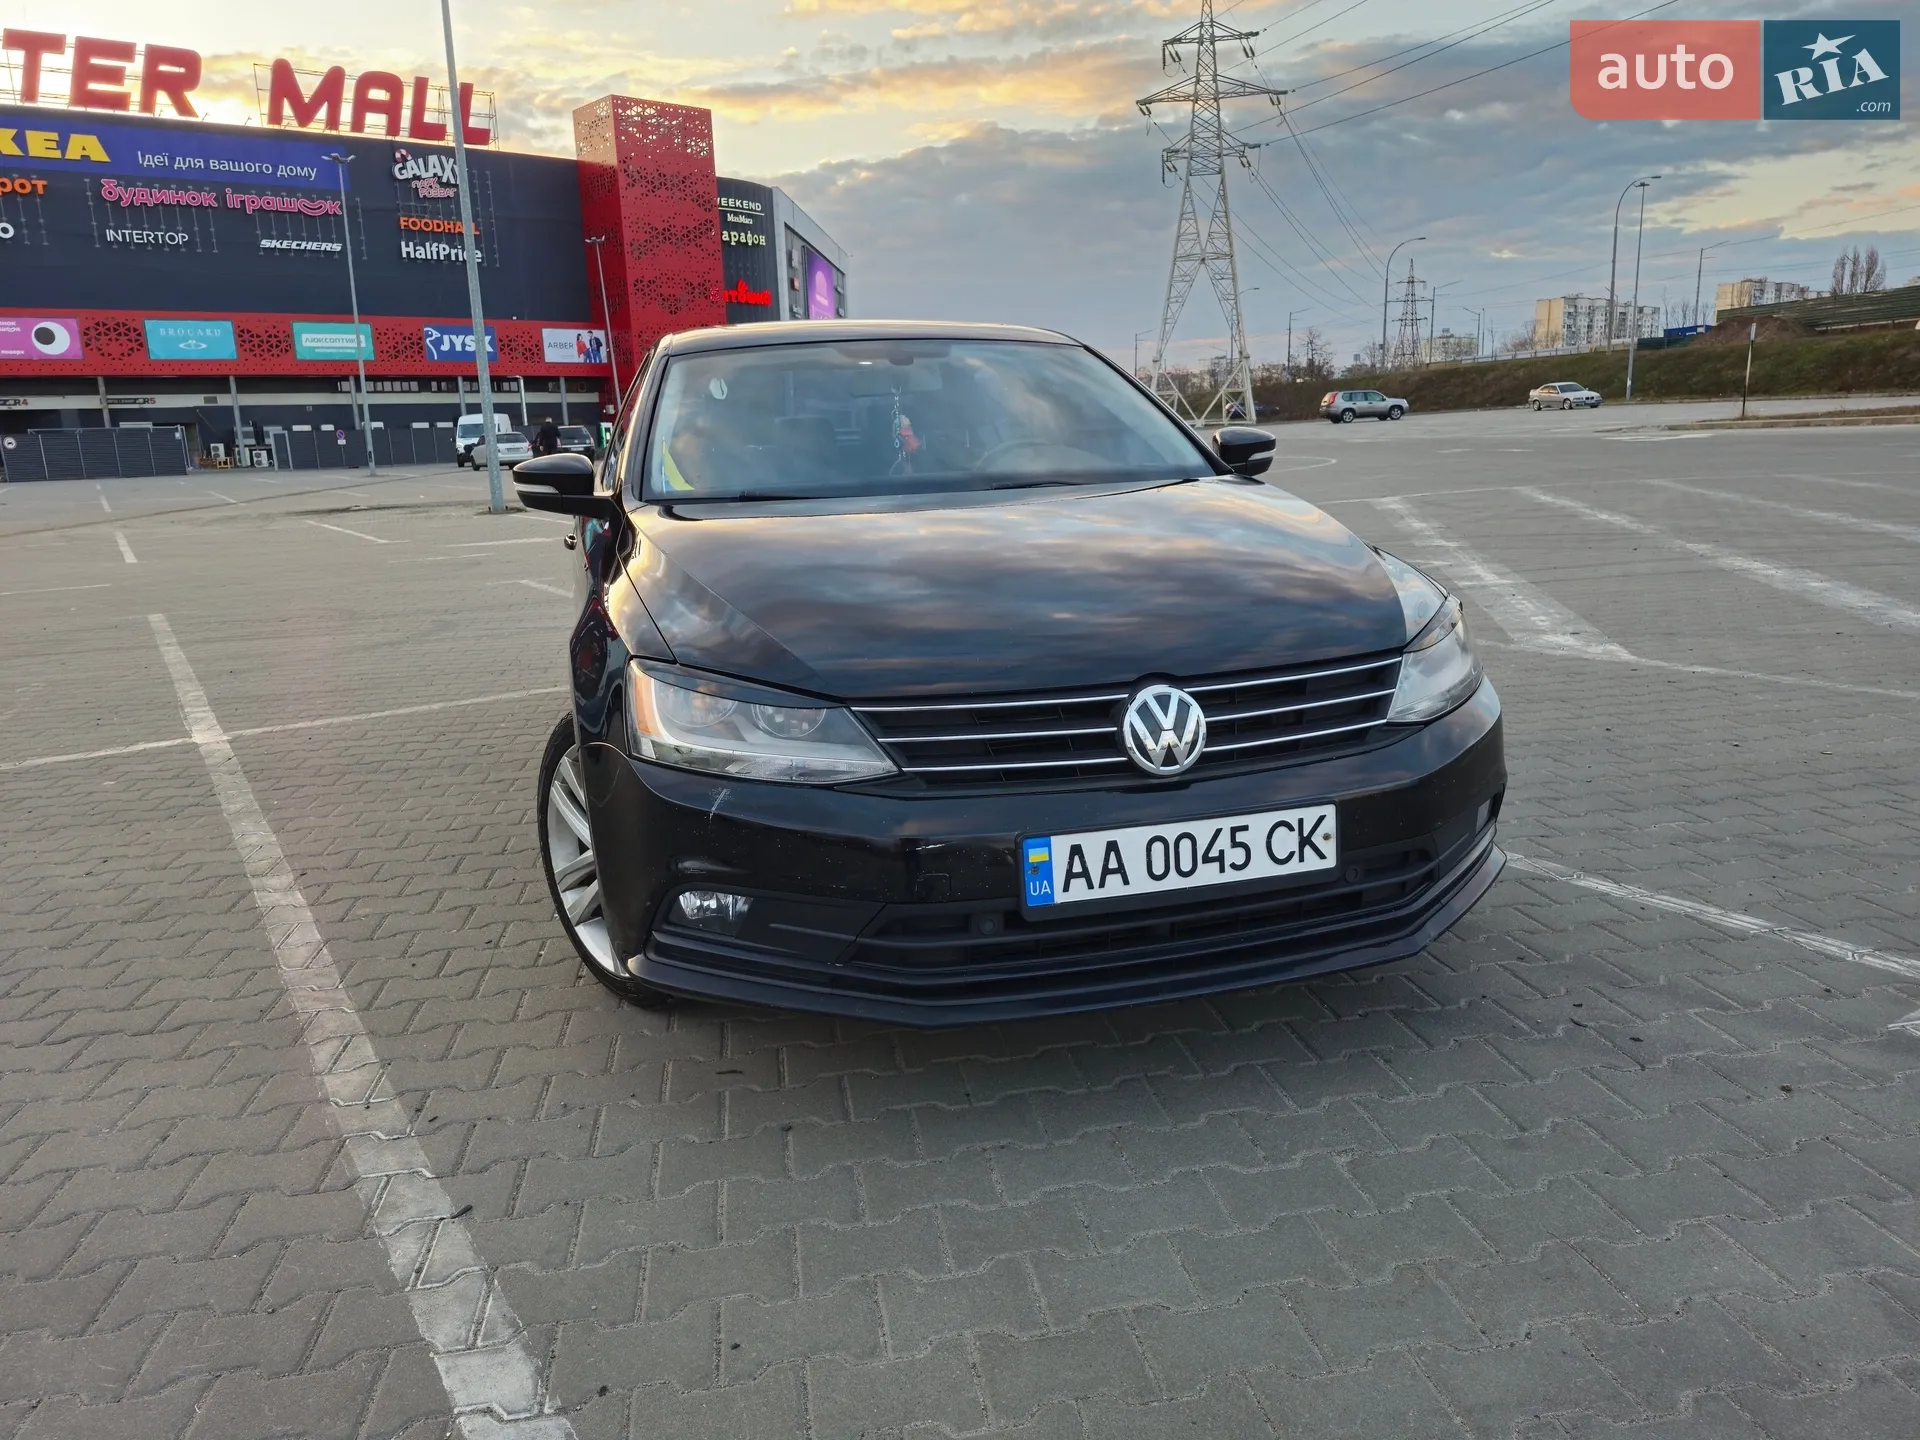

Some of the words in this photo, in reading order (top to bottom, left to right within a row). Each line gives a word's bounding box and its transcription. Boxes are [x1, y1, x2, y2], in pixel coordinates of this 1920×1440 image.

[2, 28, 202, 118] TER
[267, 58, 492, 146] MALL
[0, 128, 111, 162] KEA
[137, 151, 169, 169] Ідеї
[174, 157, 204, 170] для
[209, 159, 273, 174] вашого
[276, 164, 317, 181] дому
[101, 178, 218, 207] будинок
[225, 188, 342, 216] іграшок
[400, 216, 480, 235] FOODHAL
[106, 229, 188, 245] INTERTOP
[260, 239, 342, 252] SKECHERS
[160, 328, 221, 337] BROCARD
[547, 341, 574, 350] ARBER
[1062, 840, 1130, 893] AA
[1145, 824, 1251, 882] 0045
[1265, 814, 1328, 866] CK
[1030, 879, 1051, 896] UA
